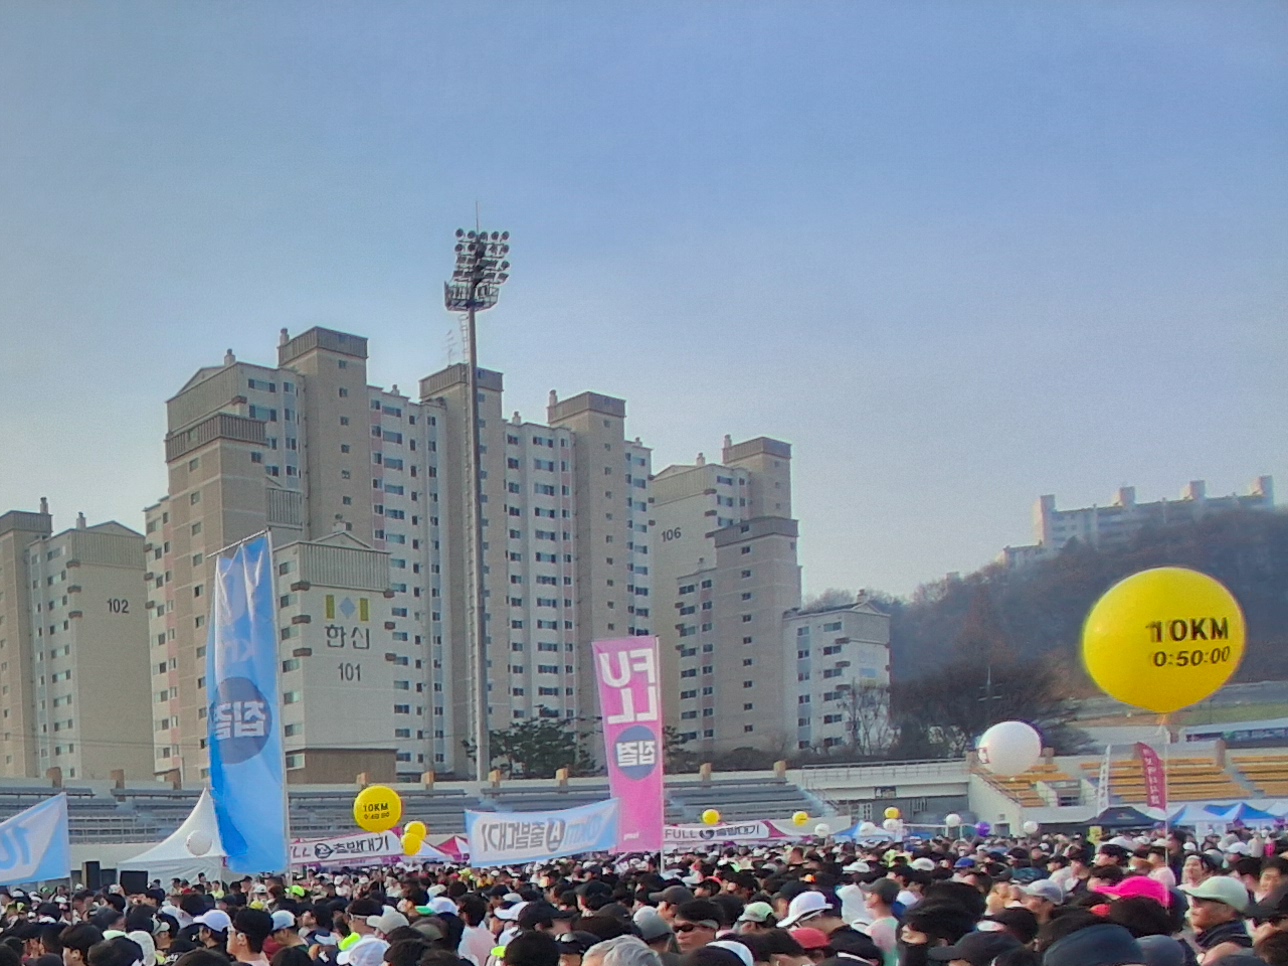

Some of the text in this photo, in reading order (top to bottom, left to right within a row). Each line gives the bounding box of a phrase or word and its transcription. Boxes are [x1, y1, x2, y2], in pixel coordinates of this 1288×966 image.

[661, 527, 682, 543] 106
[107, 598, 130, 614] 102
[324, 623, 371, 650] 한신
[1145, 616, 1230, 643] 10KM
[1151, 645, 1231, 668] 0:50:00
[337, 662, 361, 682] 101
[362, 802, 389, 812] 10KM
[665, 828, 697, 839] FULL
[290, 845, 311, 859] LL
